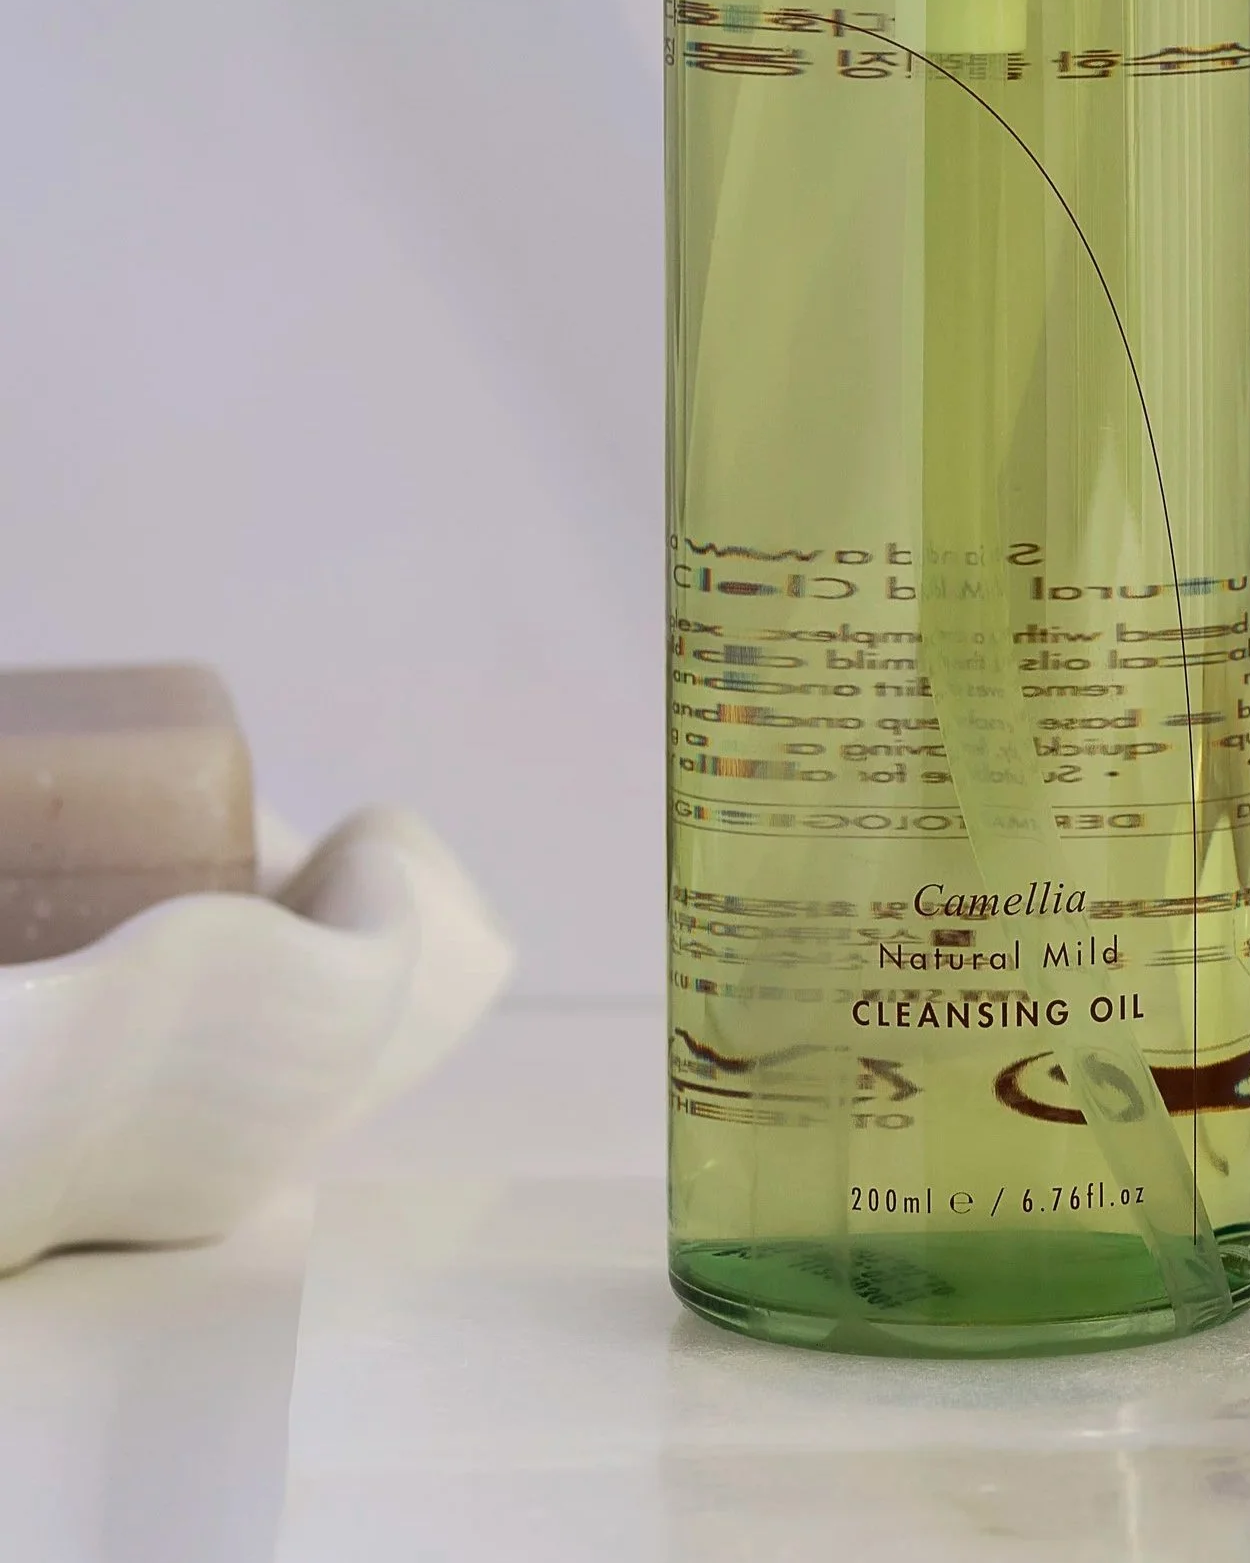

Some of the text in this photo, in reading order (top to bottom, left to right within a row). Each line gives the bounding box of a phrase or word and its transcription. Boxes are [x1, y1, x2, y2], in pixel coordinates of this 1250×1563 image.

[914, 881, 1087, 917] Camellia
[879, 939, 1020, 971] Natural
[1043, 934, 1118, 969] Mild
[852, 993, 1144, 1028] CLEANSING OIL
[851, 1187, 931, 1213] 200ml
[991, 1187, 1005, 1216] /
[1022, 1182, 1144, 1213] 6.76fl.oz
